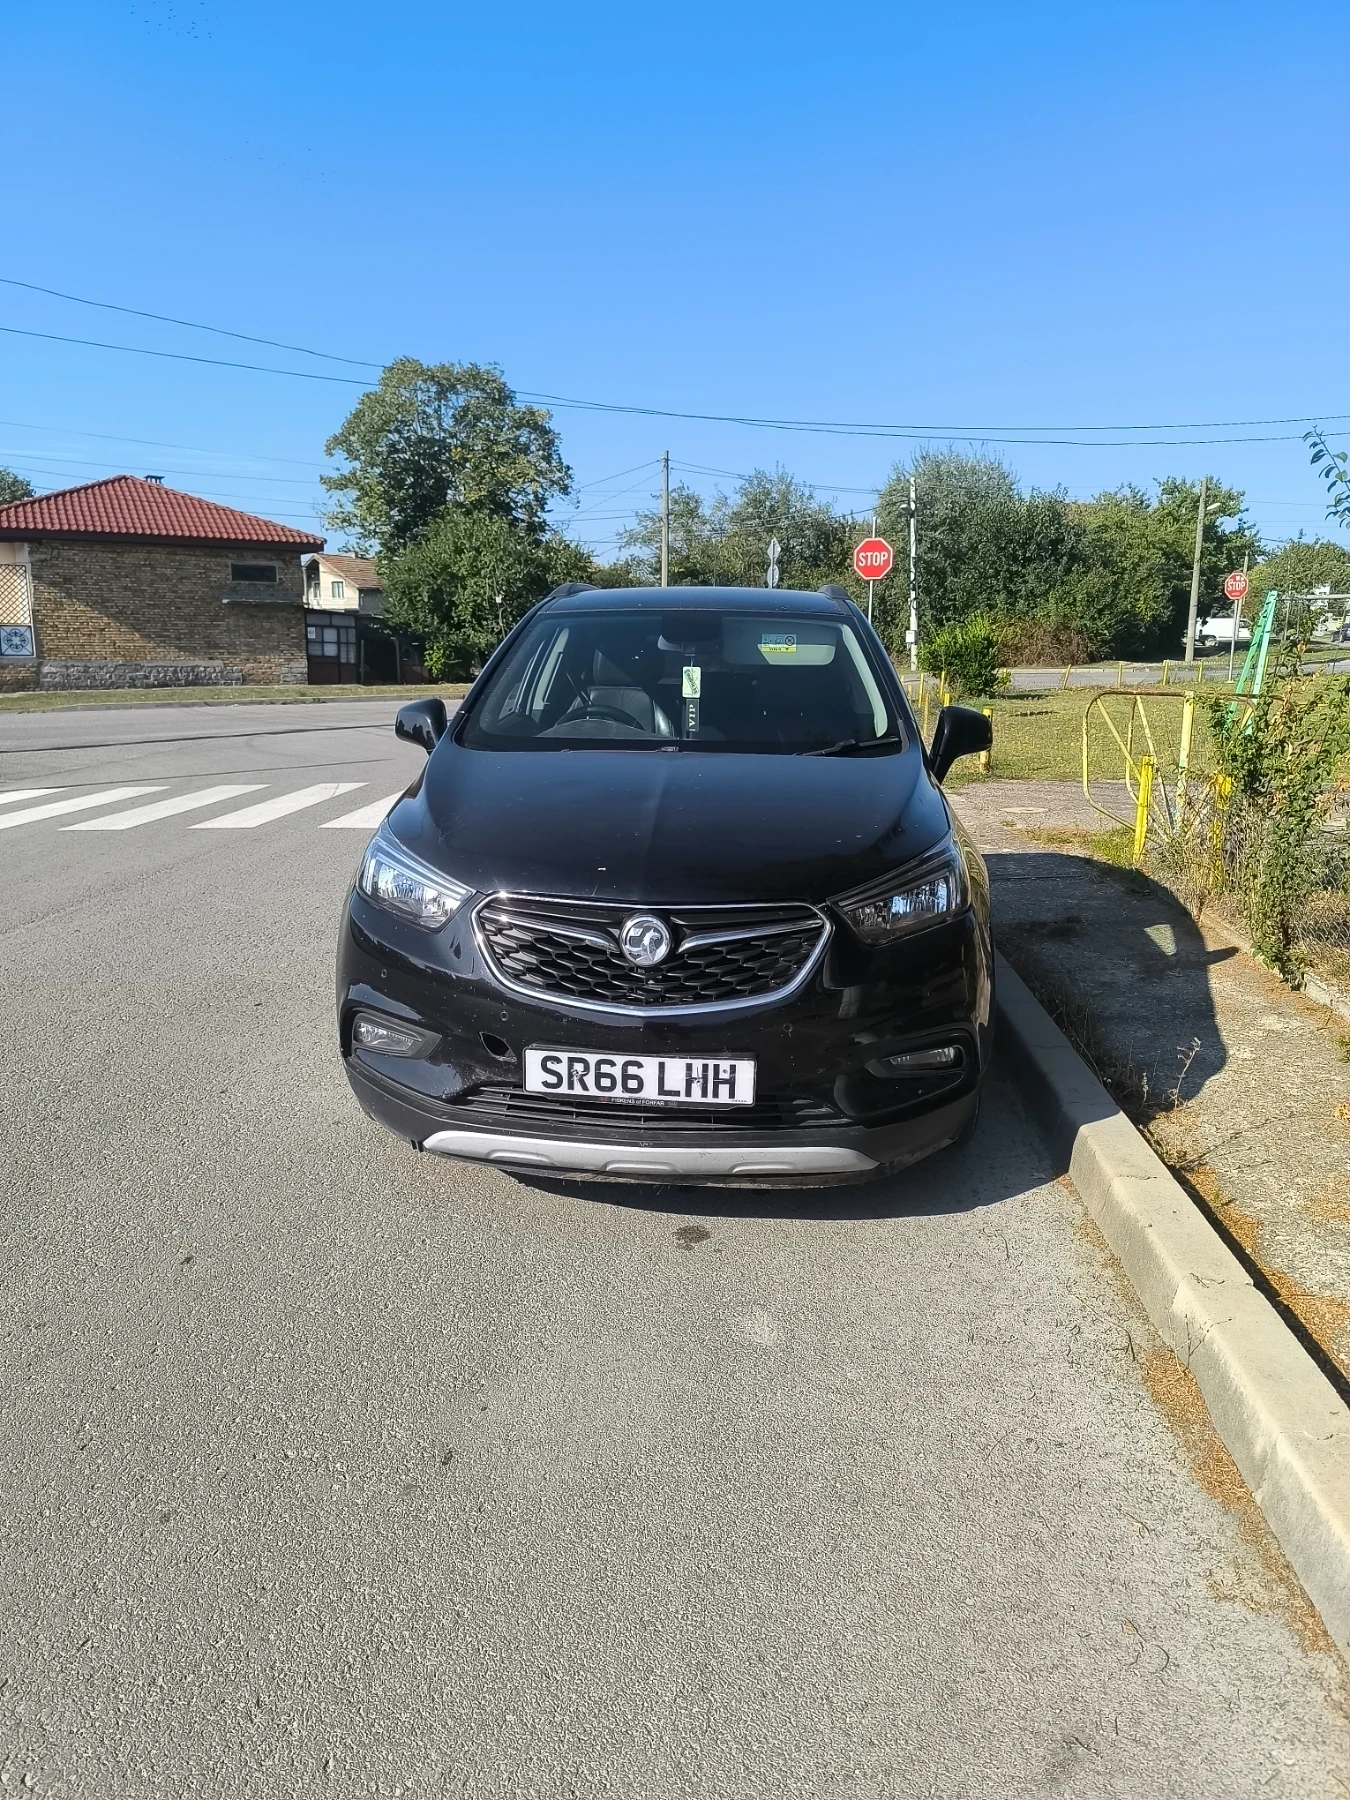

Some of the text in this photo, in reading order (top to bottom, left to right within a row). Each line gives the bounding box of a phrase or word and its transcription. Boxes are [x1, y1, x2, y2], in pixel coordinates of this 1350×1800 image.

[858, 551, 888, 567] STOP
[1227, 581, 1246, 591] STOP
[688, 704, 696, 728] VIP
[540, 1055, 737, 1100] SR66 LHH
